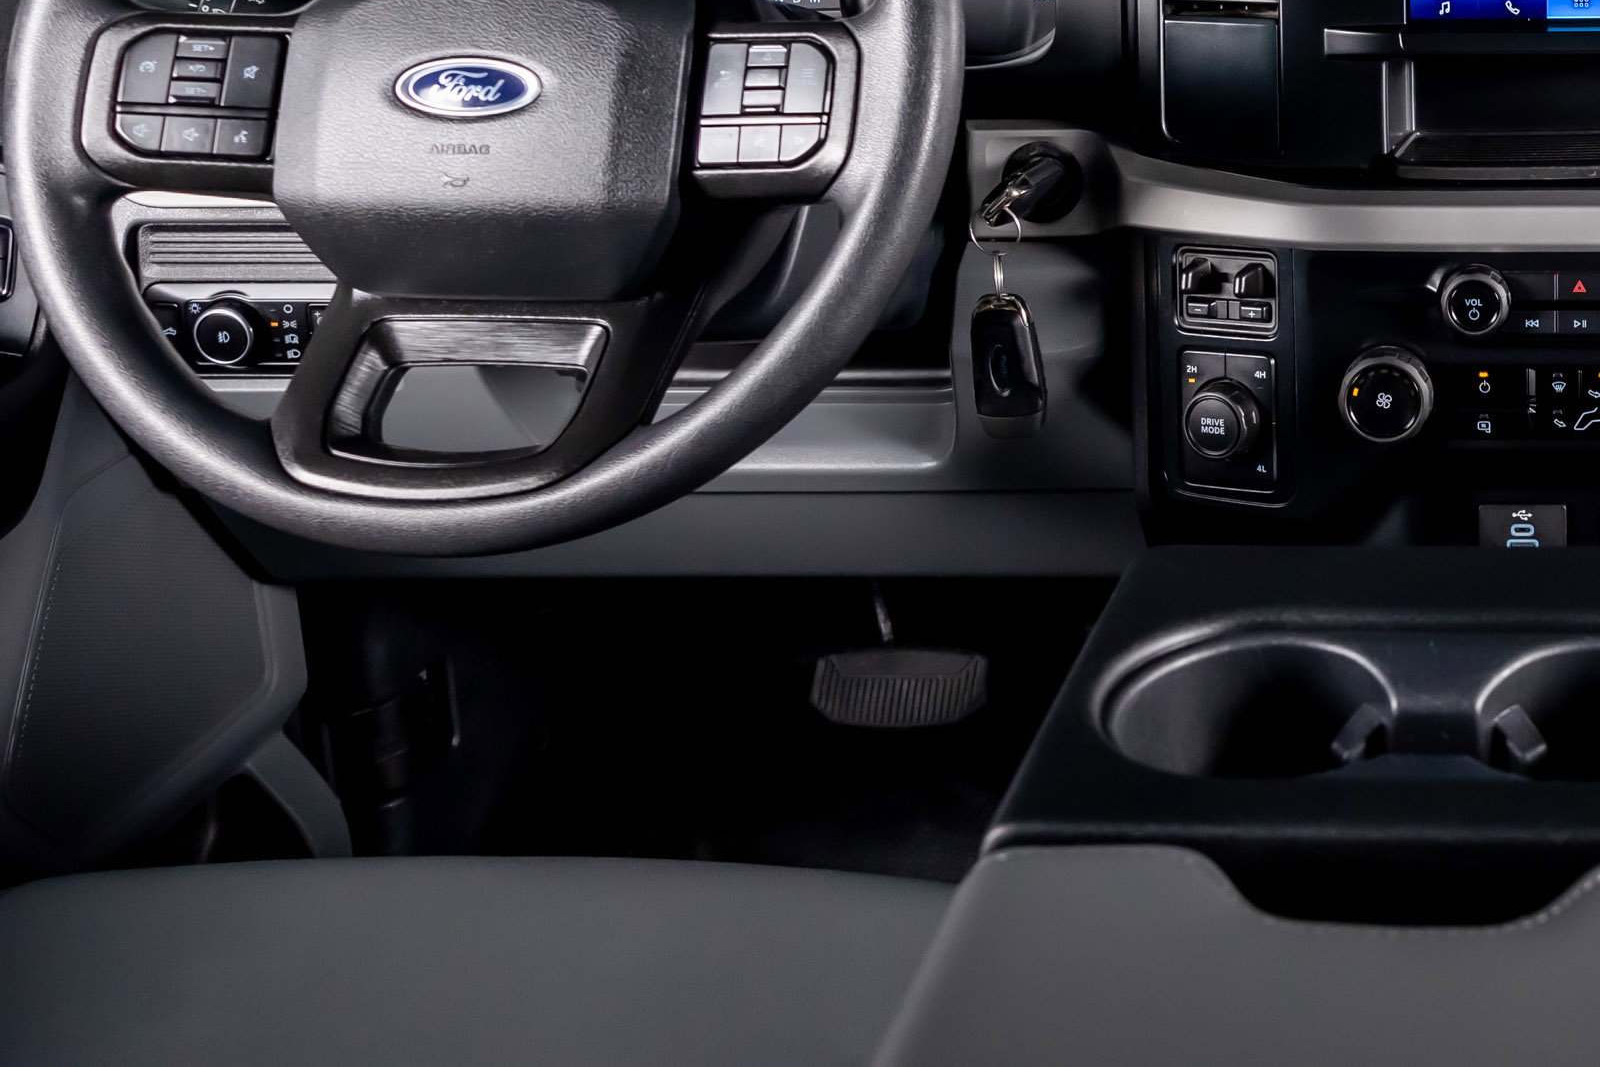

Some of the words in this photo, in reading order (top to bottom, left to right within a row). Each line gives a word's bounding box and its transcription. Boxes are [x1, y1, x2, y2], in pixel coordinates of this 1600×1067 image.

[431, 69, 505, 102] Ford
[430, 143, 491, 155] AIRBAG
[1464, 298, 1483, 307] VOL
[1186, 364, 1198, 374] 2H
[1254, 370, 1267, 379] 4H
[1200, 417, 1225, 427] DRIVE
[1201, 425, 1225, 435] MODE
[1256, 464, 1267, 473] 4L
